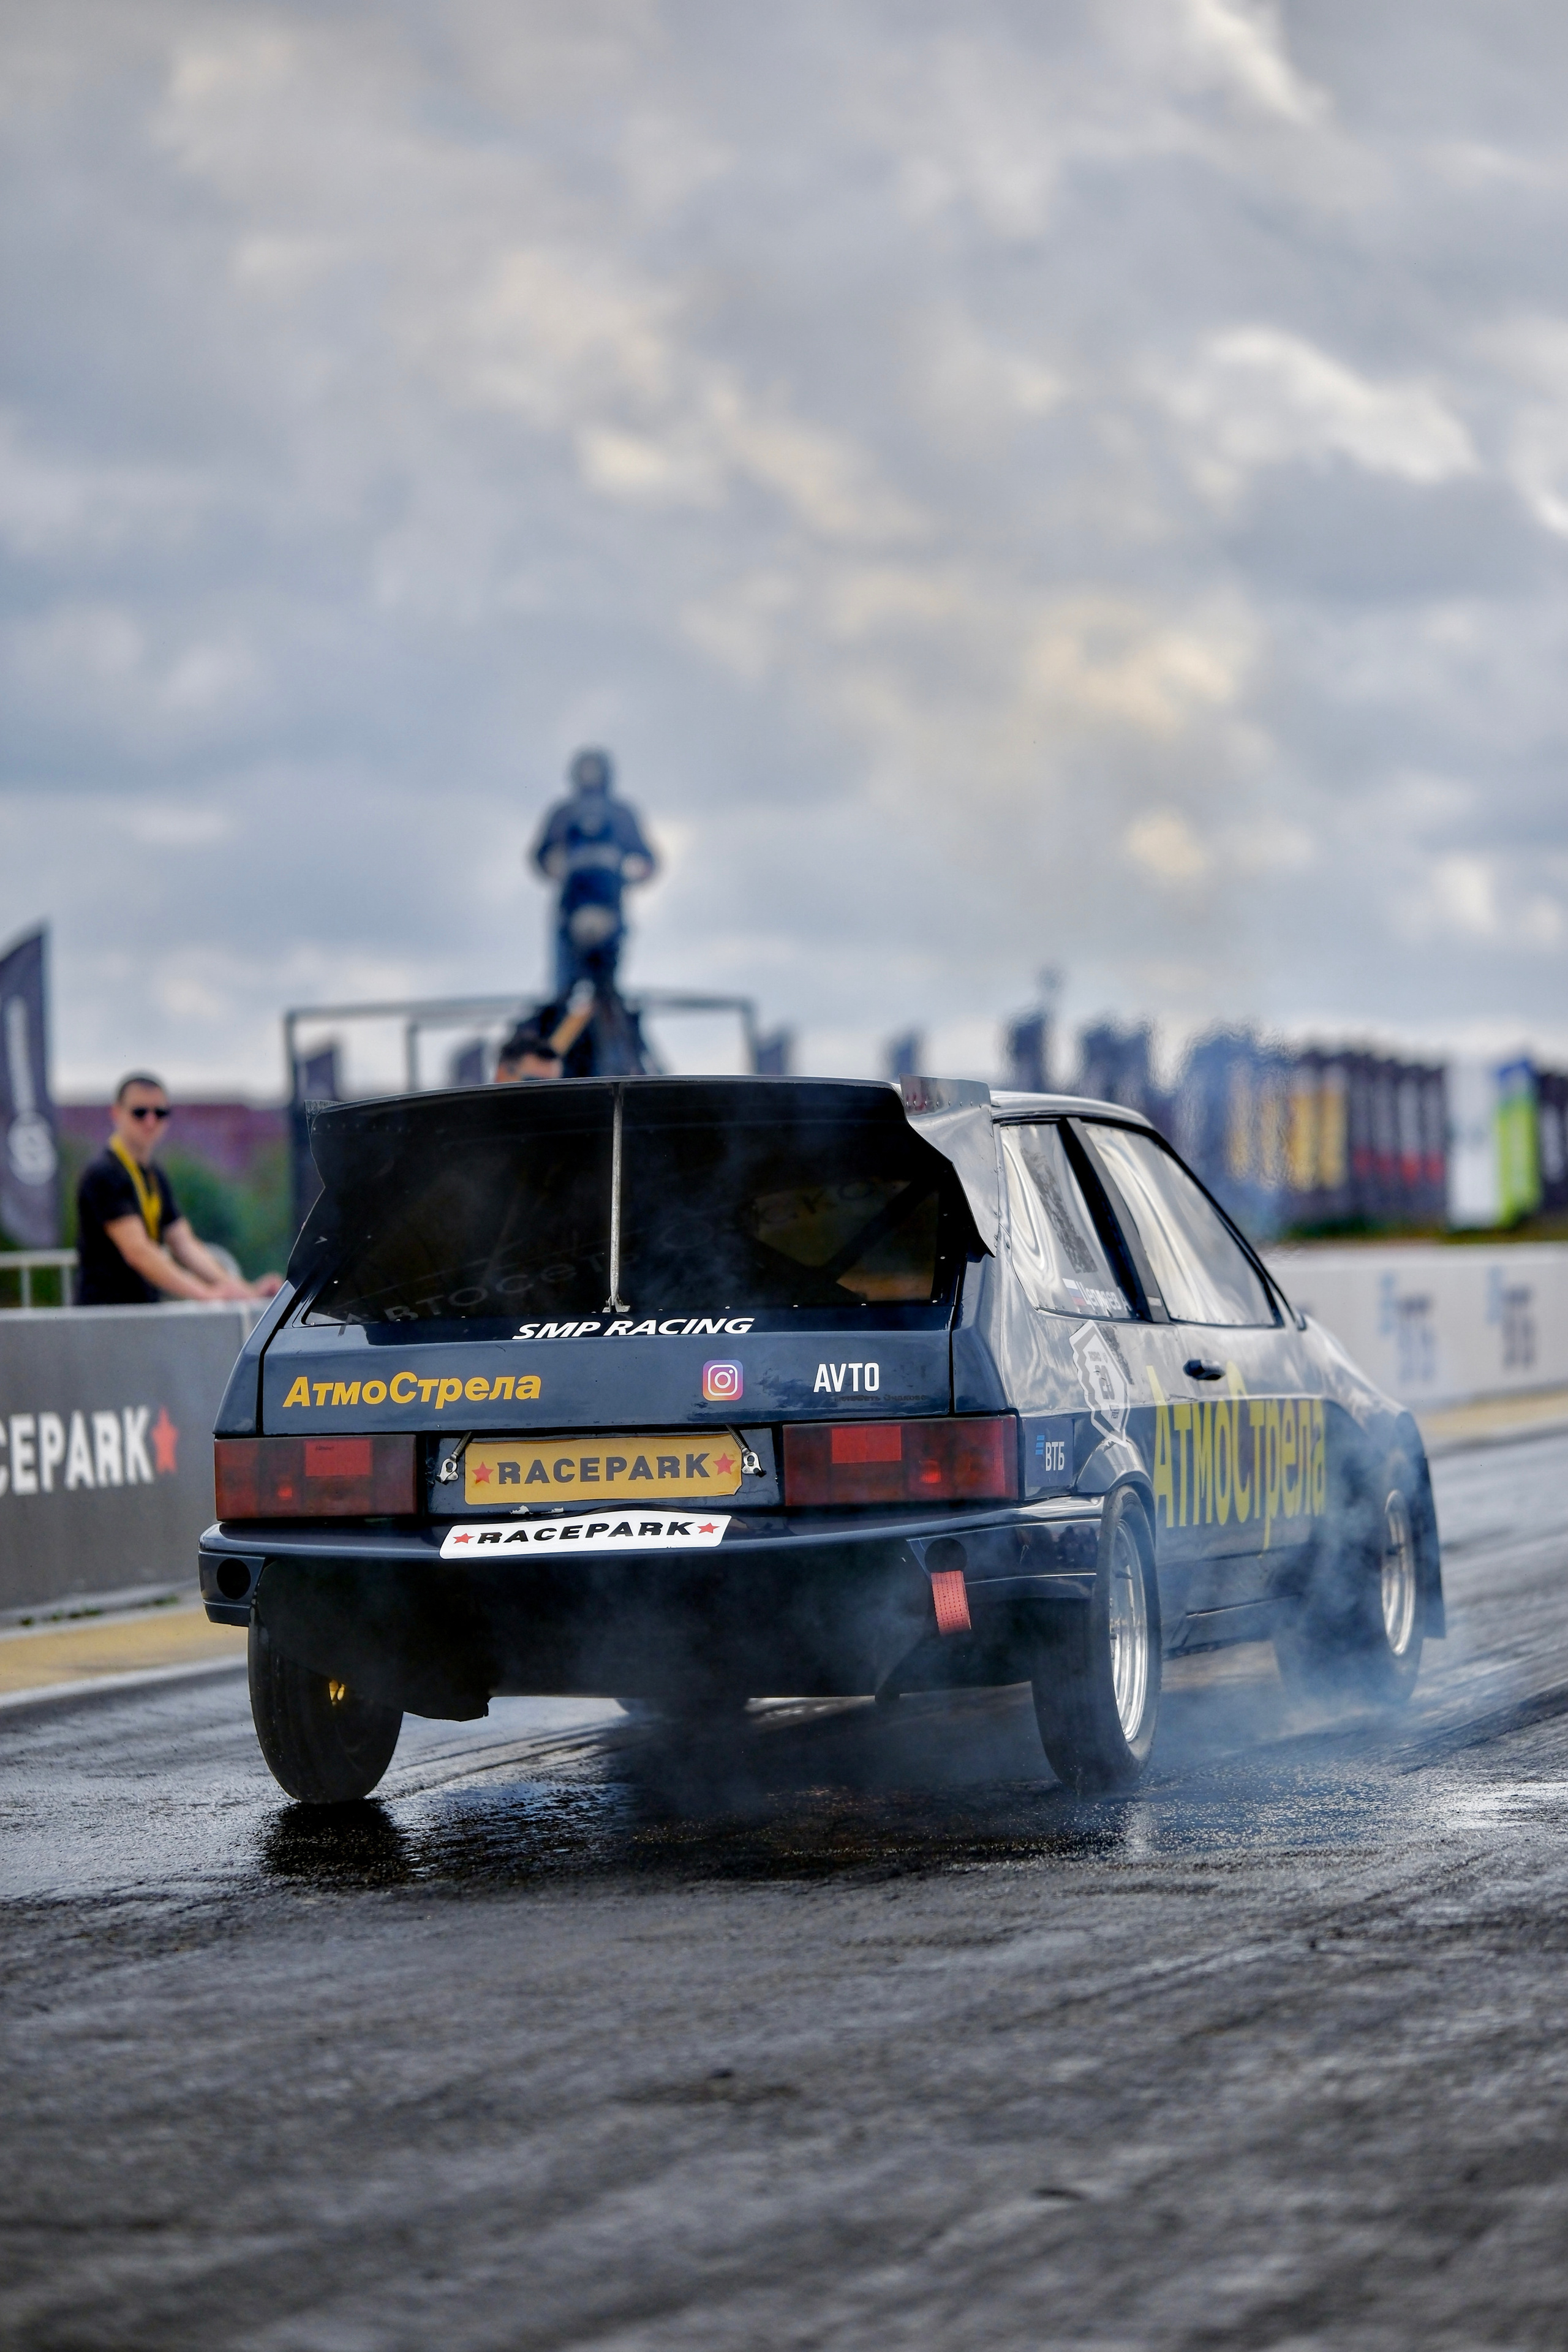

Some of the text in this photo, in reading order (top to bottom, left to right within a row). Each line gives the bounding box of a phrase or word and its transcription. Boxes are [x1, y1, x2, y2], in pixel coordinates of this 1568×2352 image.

[512, 1317, 755, 1341] SMP RACING
[282, 1371, 542, 1409] АтмоСтрела
[813, 1362, 880, 1393] AVTO
[497, 1453, 710, 1485] RACEPARK
[1046, 1441, 1065, 1471] ВТБ
[1146, 1360, 1325, 1558] АтмоСтрела
[477, 1521, 695, 1544] RACEPARK
